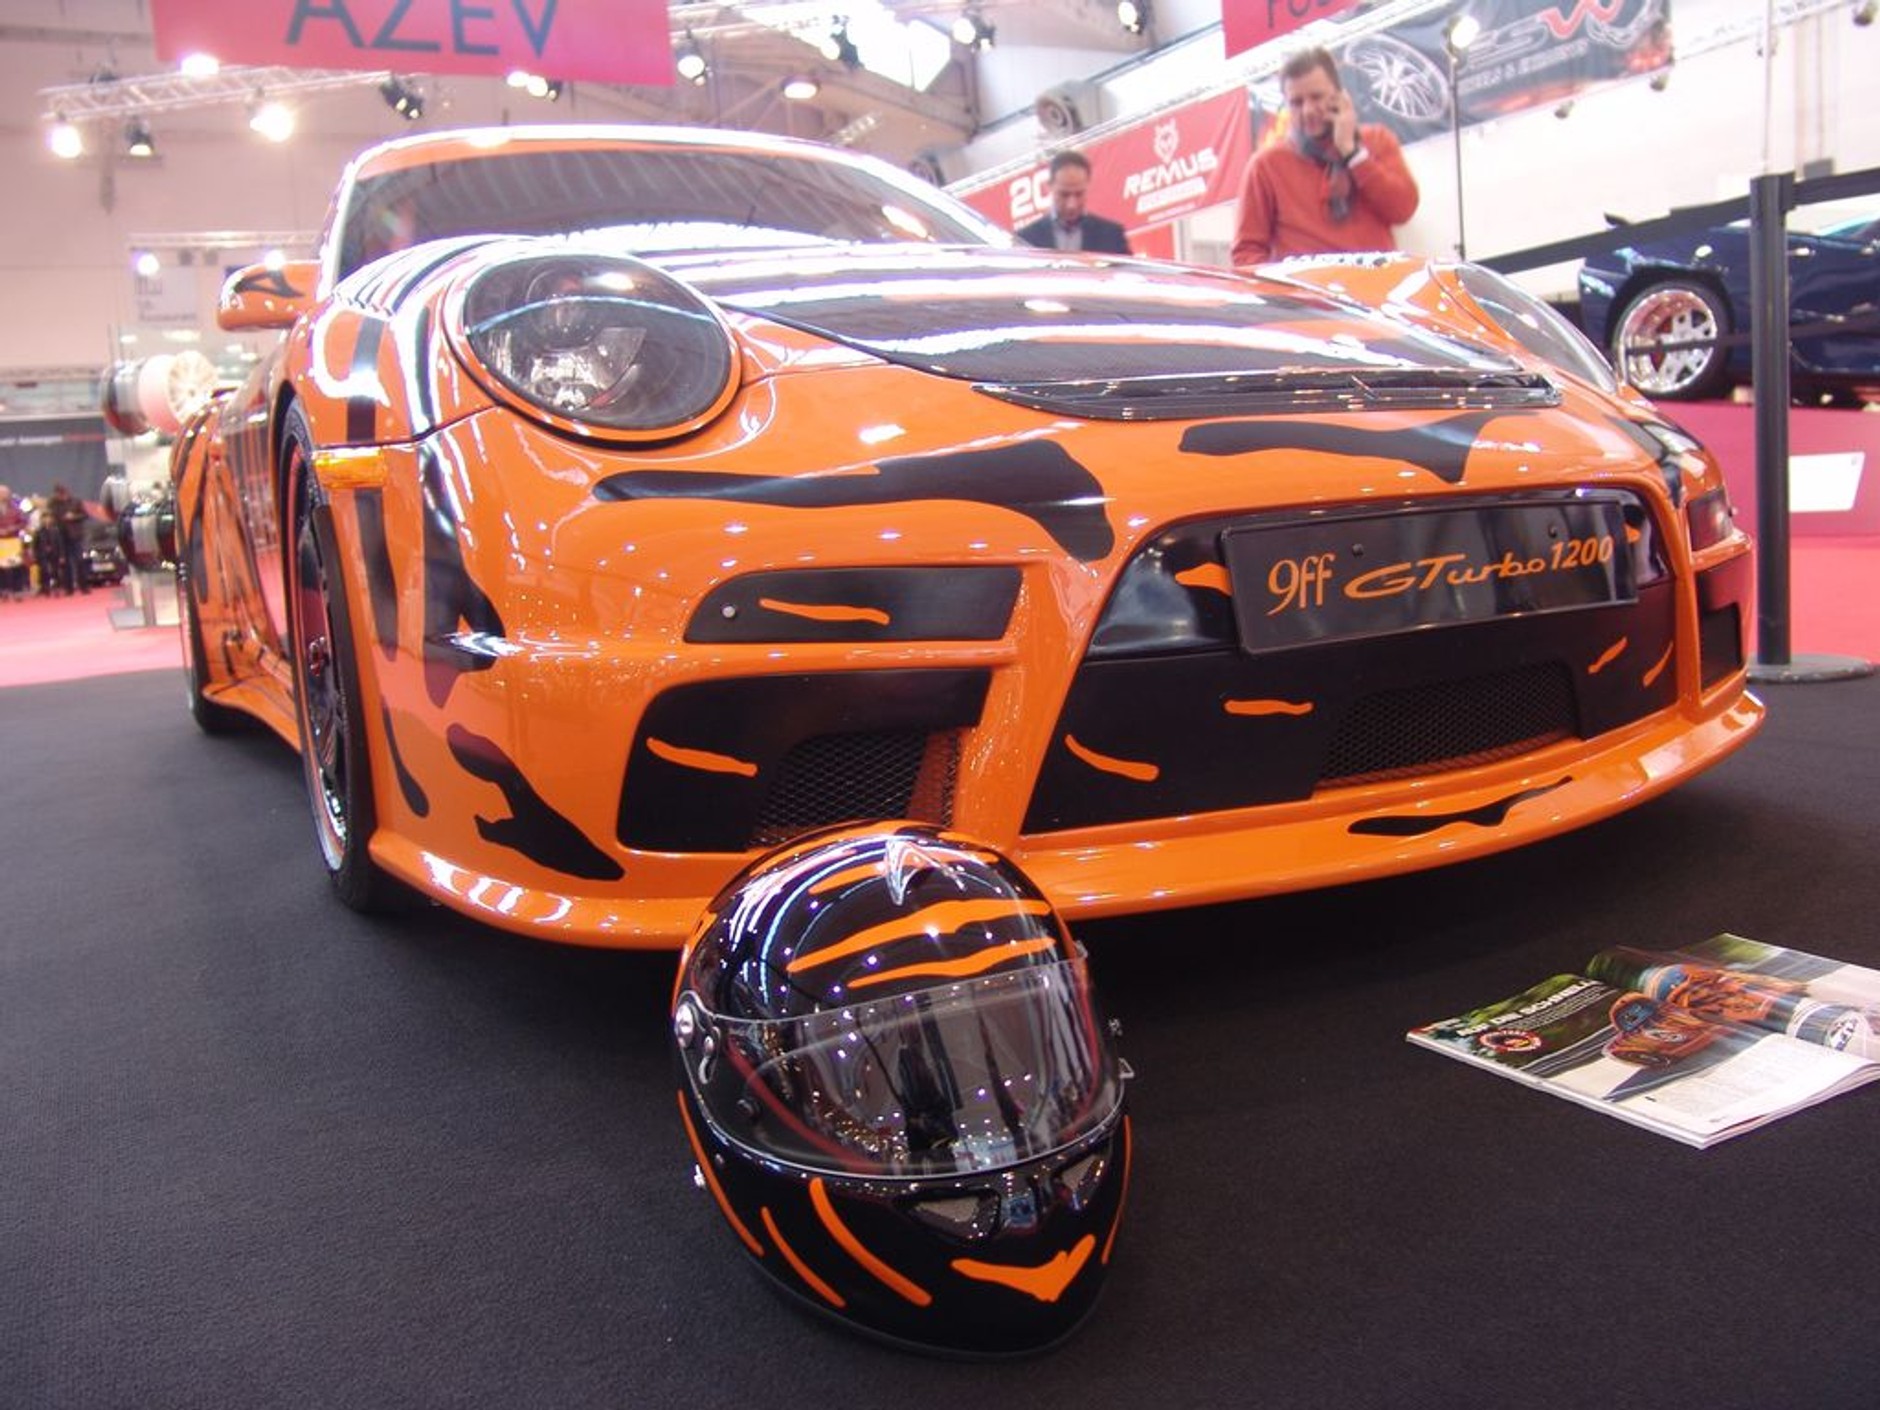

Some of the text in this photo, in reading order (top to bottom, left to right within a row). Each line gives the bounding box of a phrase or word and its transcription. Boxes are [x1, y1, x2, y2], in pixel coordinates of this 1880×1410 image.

[284, 0, 559, 58] AZEV
[1123, 147, 1218, 199] REMUS
[1266, 535, 1615, 616] 9ff GTurbo 1200
